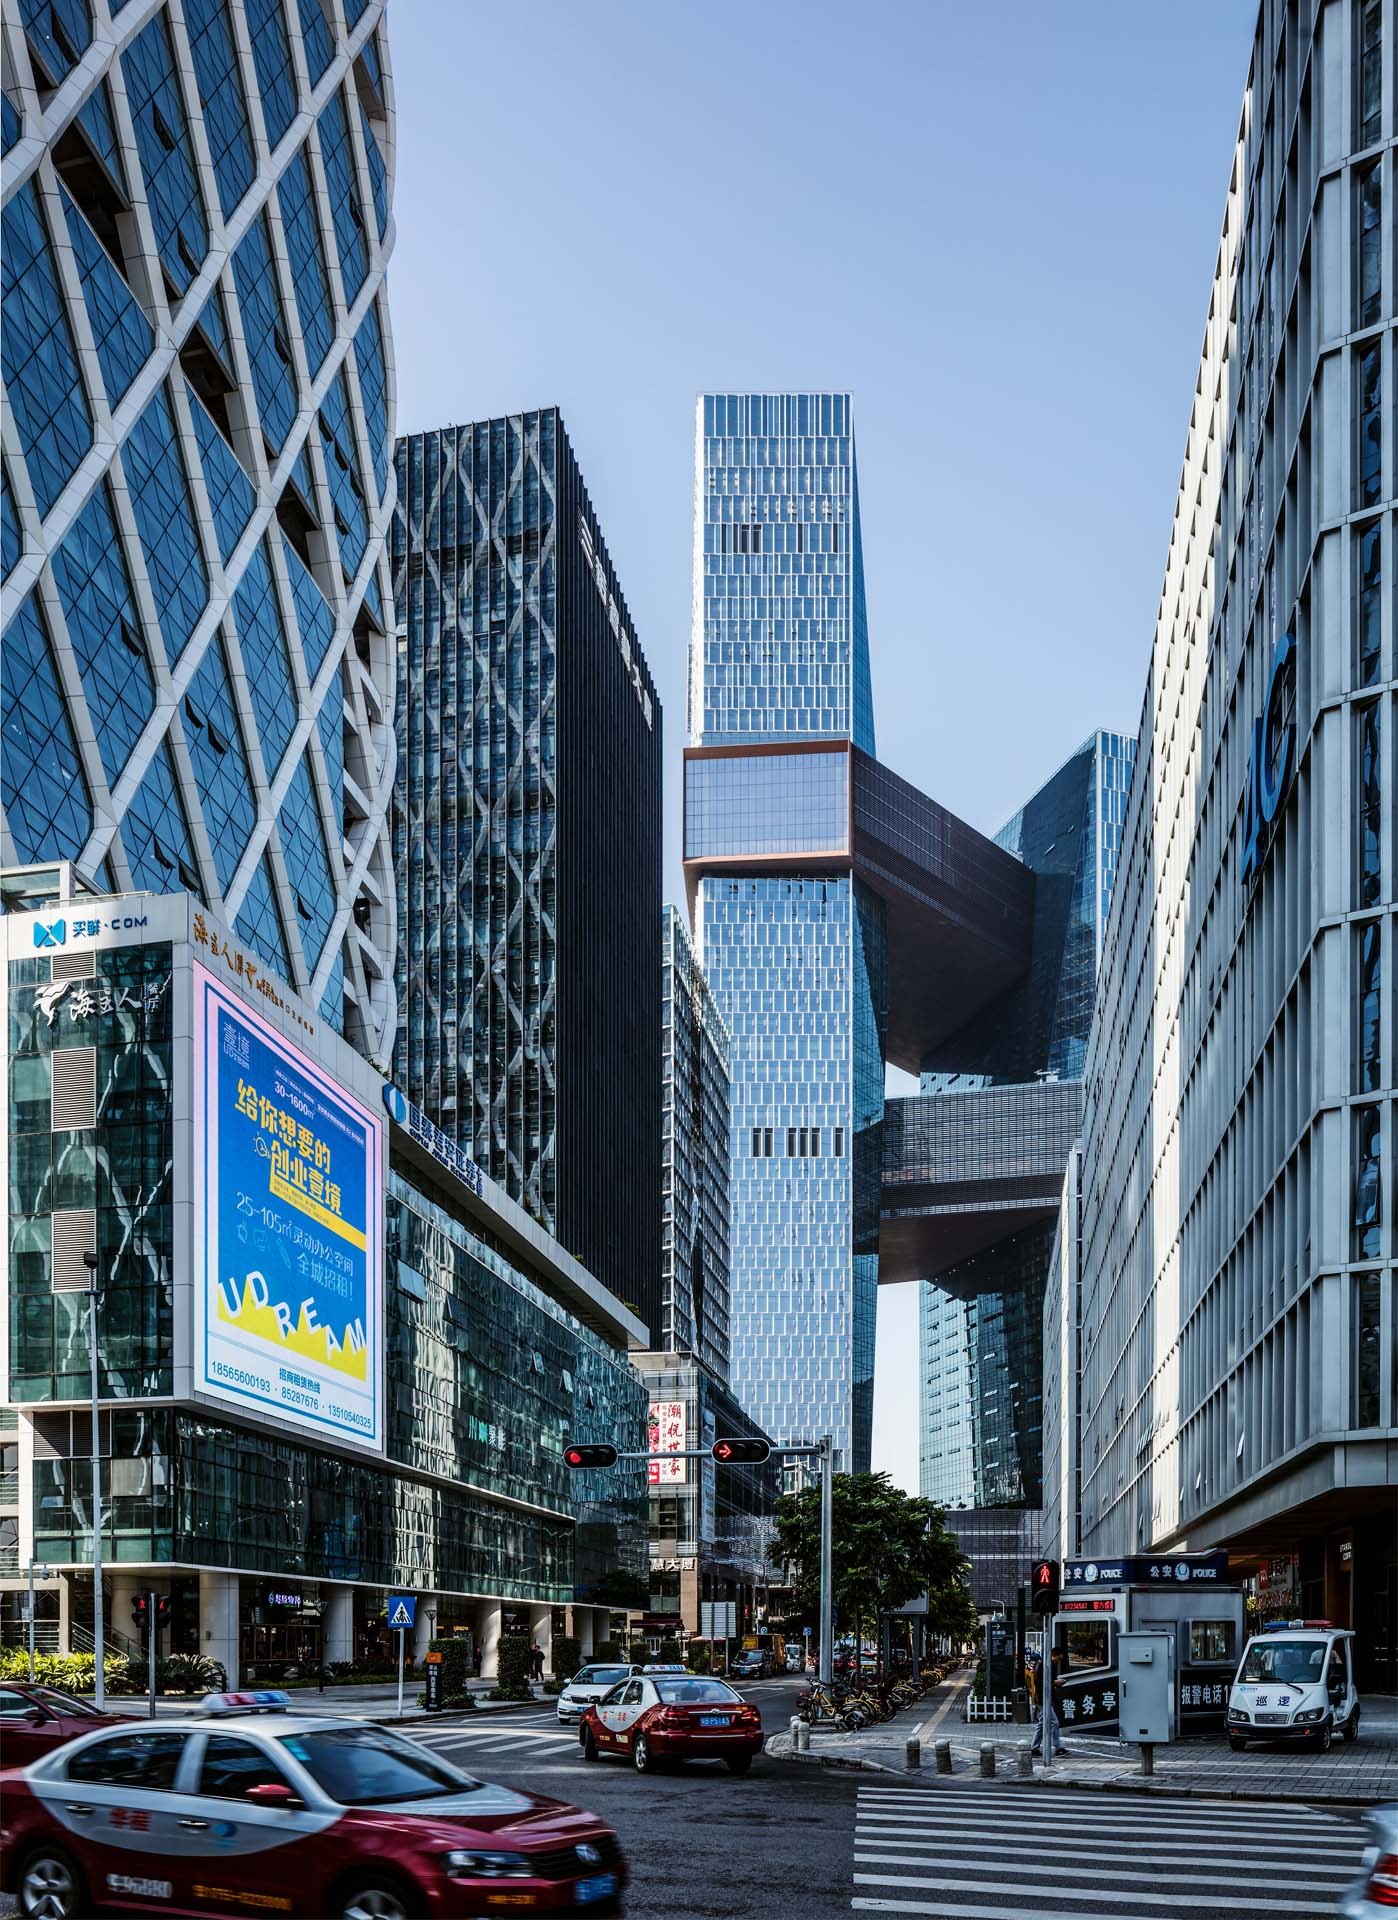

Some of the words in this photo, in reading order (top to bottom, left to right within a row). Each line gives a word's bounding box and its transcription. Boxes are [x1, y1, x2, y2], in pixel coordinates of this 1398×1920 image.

[234, 1077, 331, 1175] 给你想要的
[270, 1139, 342, 1217] 创业壹境
[211, 1361, 271, 1393] 18565600193
[281, 1387, 319, 1410] 85287676
[328, 1405, 372, 1430] 13510540325
[279, 1367, 321, 1395] 招商租赁热线
[1064, 1566, 1082, 1580] 公安
[1100, 1568, 1123, 1578] POLICE
[1150, 1565, 1172, 1578] 公安
[1192, 1568, 1217, 1578] POLICE
[1062, 1690, 1117, 1720] 警务亭
[1256, 1696, 1291, 1707] 巡逻
